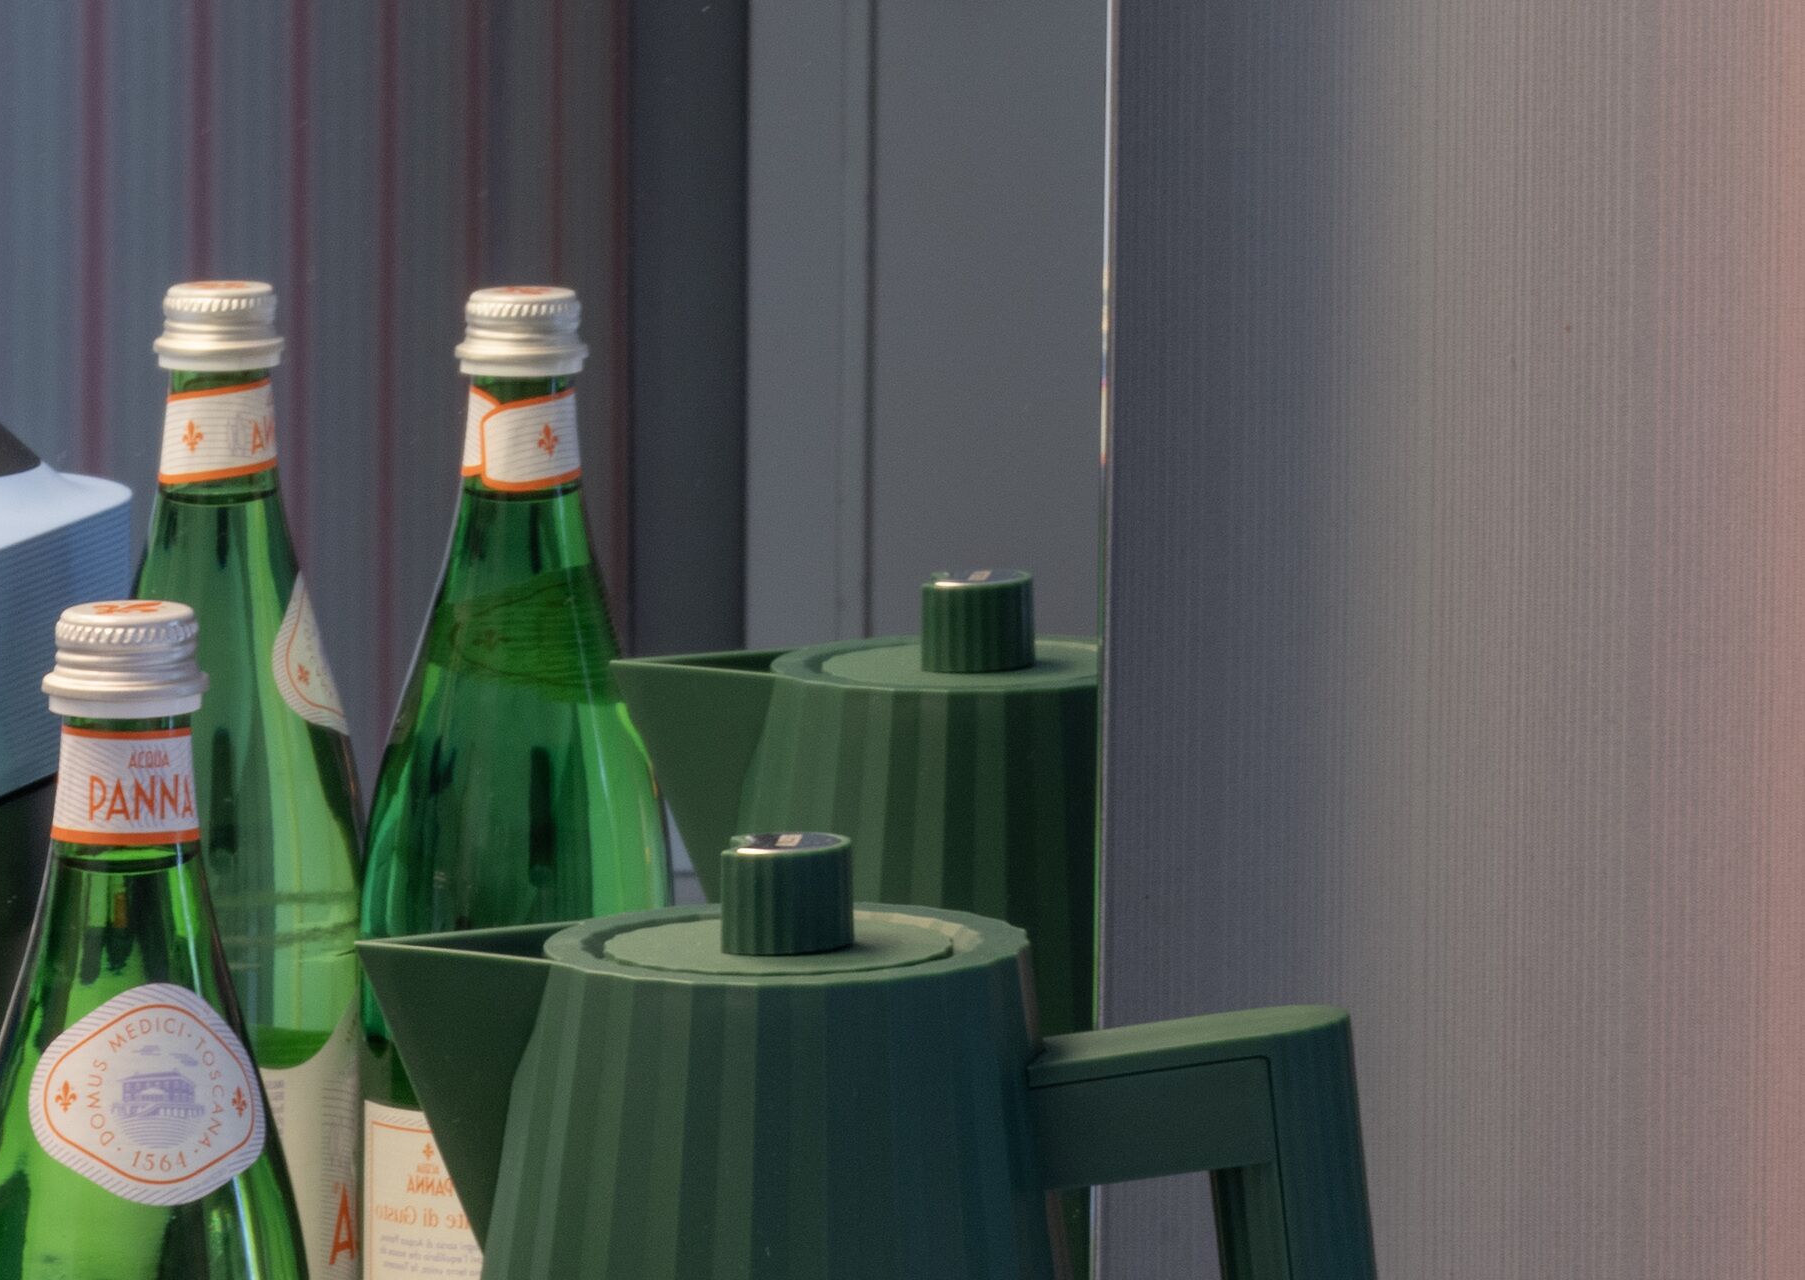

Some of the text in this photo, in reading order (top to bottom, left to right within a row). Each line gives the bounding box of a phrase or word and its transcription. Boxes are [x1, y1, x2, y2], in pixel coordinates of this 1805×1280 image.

[128, 751, 170, 769] ACQUA
[89, 773, 195, 821] PANNA
[86, 1059, 115, 1147] DOMUS
[108, 1017, 186, 1053] MEDICI
[194, 1036, 226, 1148] TOSCANA
[130, 1150, 188, 1173] 1564
